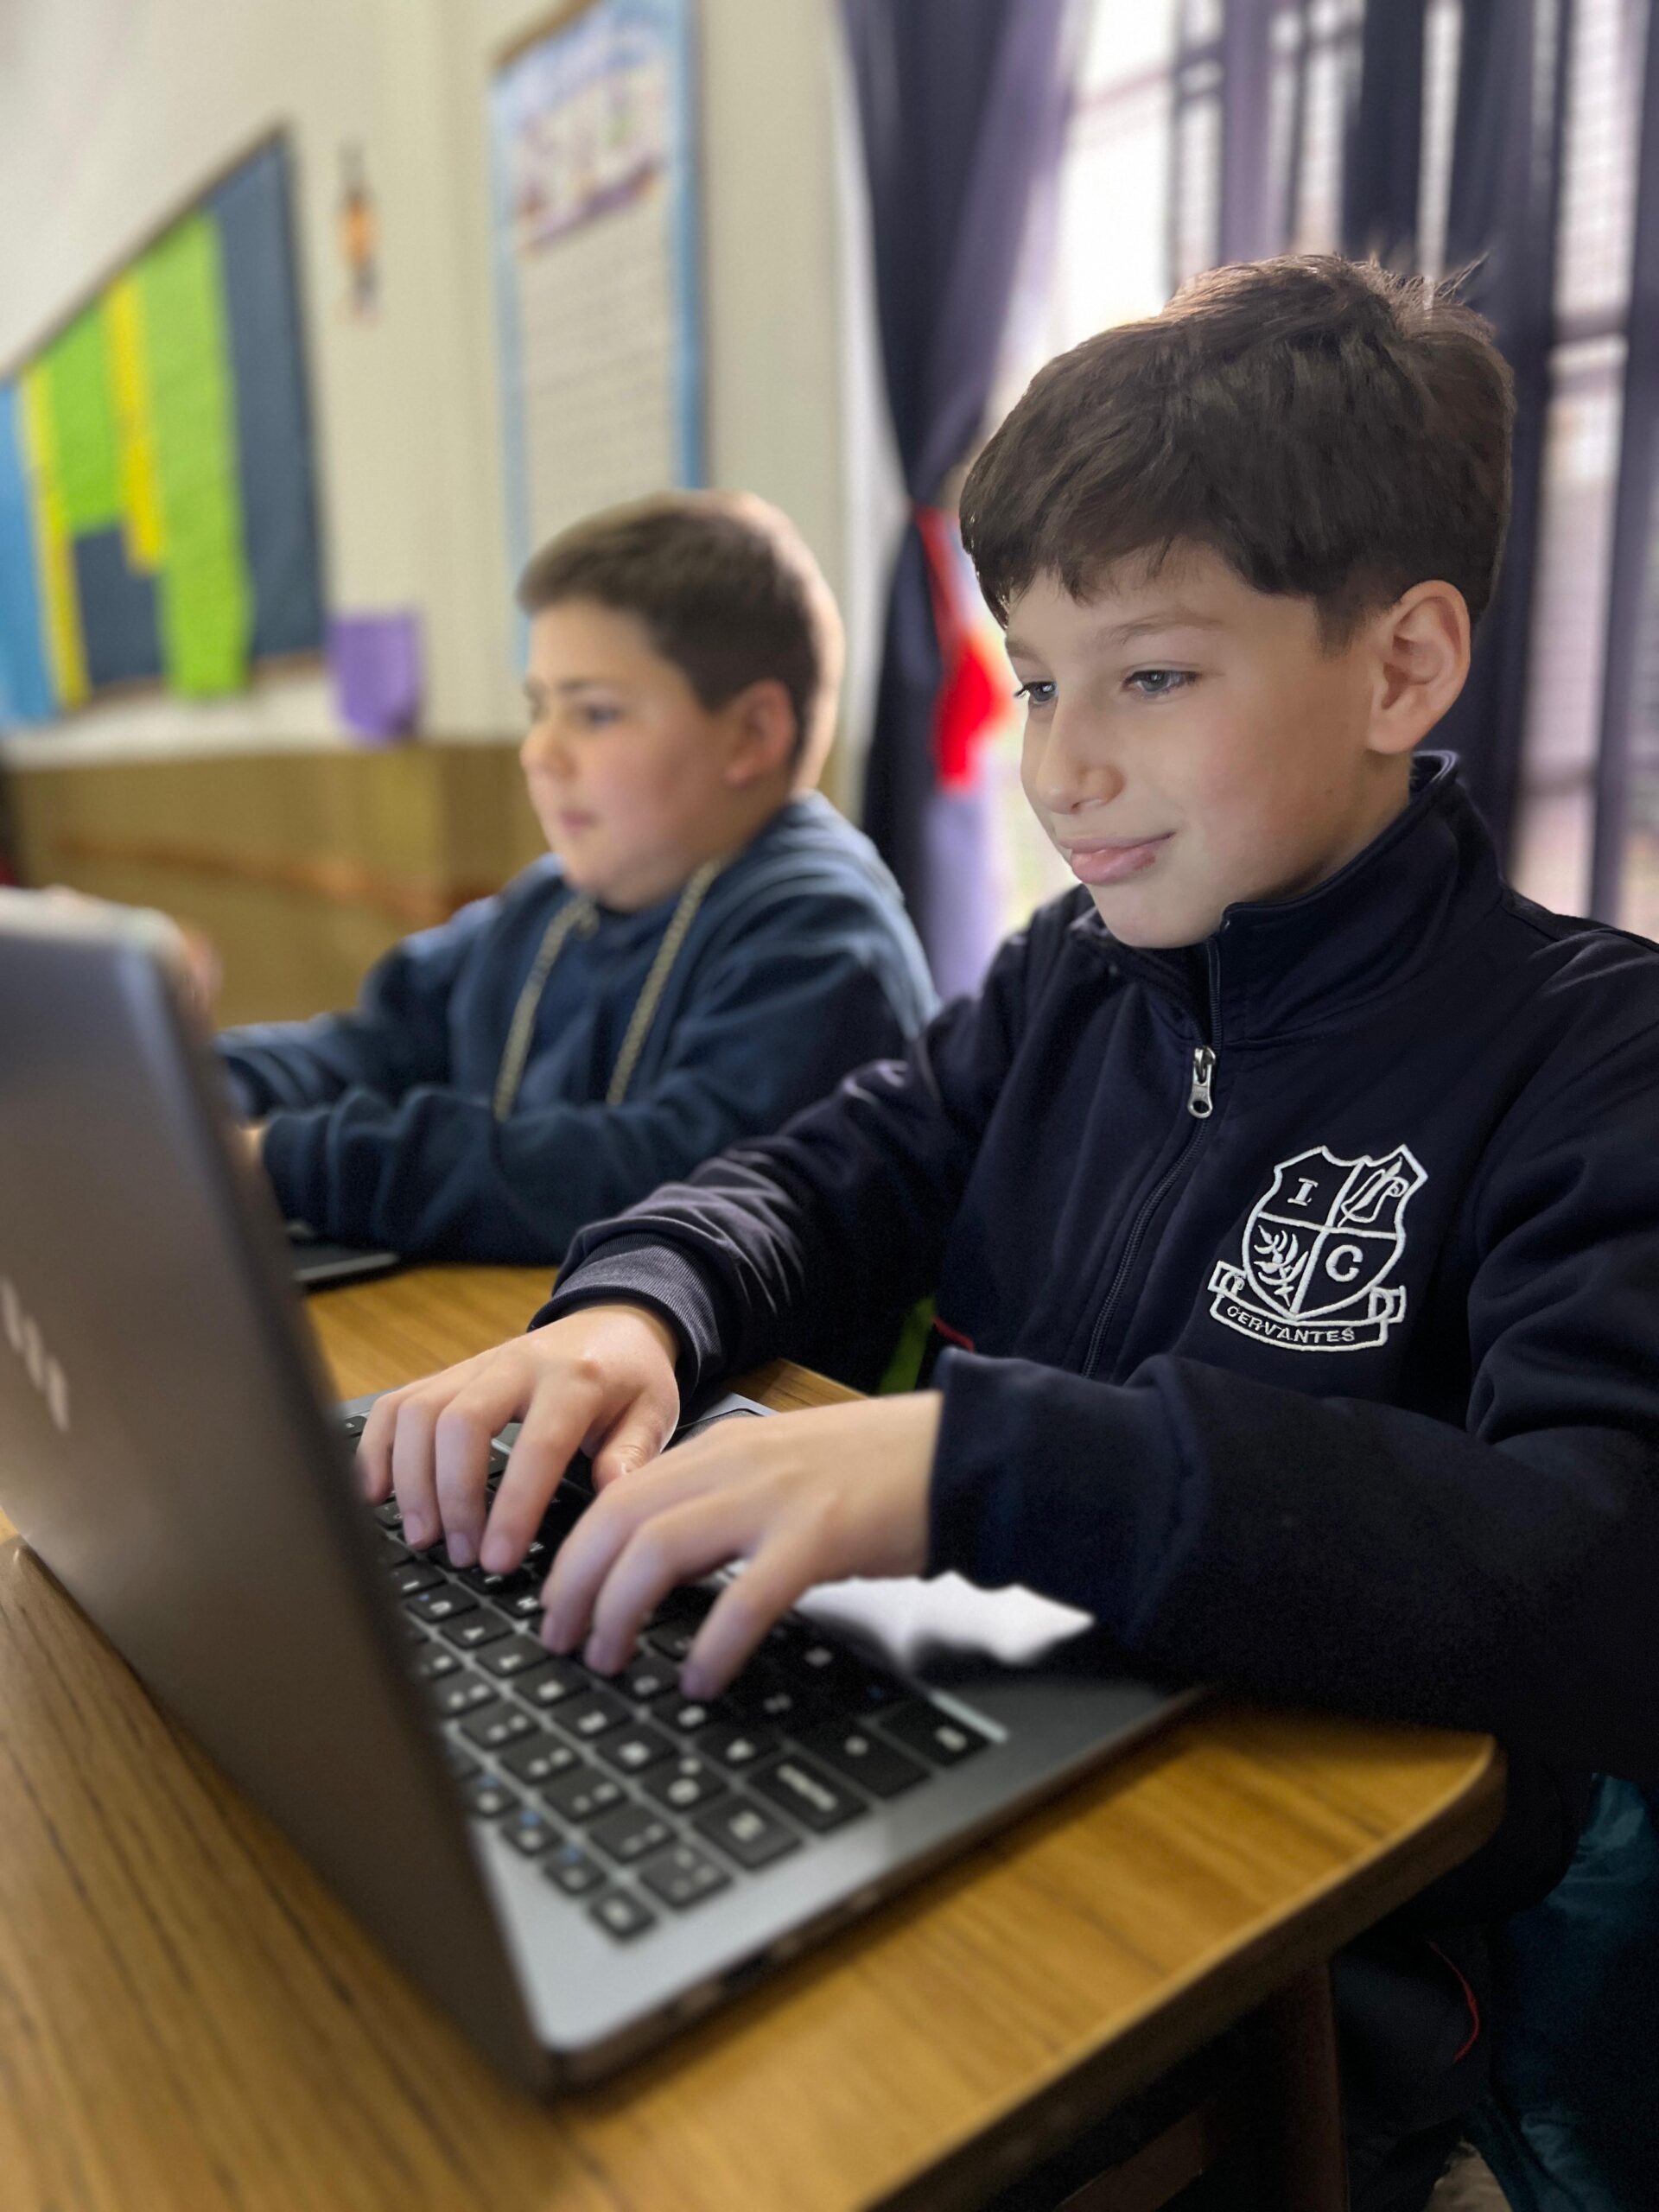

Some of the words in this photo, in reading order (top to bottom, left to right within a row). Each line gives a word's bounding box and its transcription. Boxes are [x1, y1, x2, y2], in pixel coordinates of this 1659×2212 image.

[1287, 1177, 1319, 1206] I
[1325, 1244, 1363, 1282] C
[1227, 1306, 1355, 1343] CERVANTES
